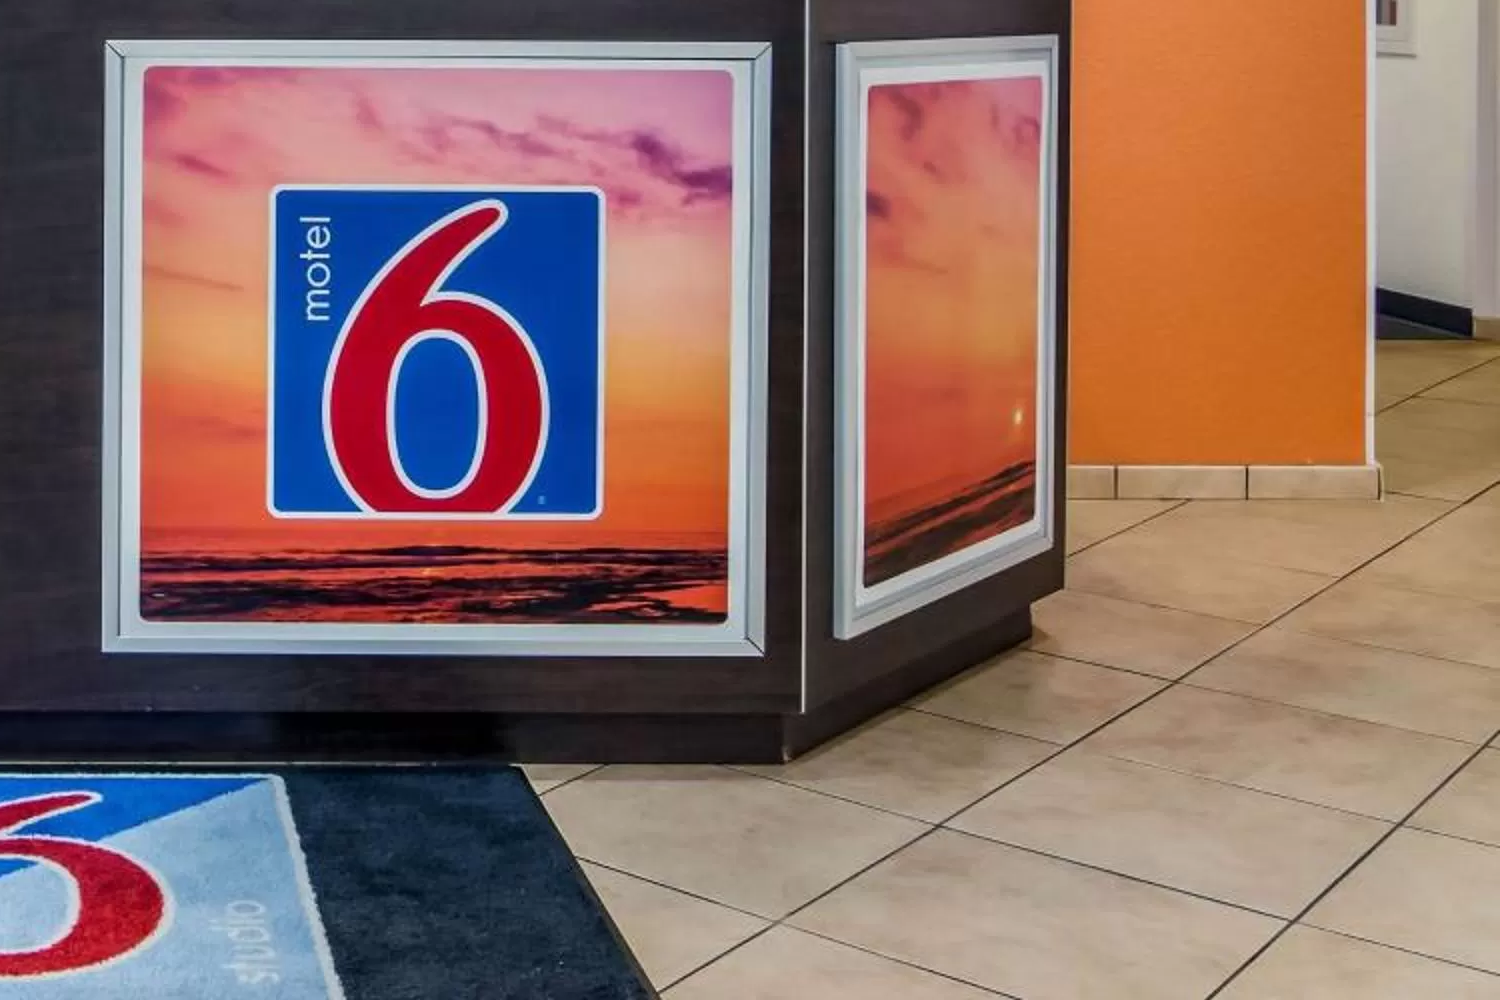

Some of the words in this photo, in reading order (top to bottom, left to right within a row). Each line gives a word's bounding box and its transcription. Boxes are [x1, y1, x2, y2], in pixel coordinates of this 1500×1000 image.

[299, 216, 331, 322] motel
[321, 198, 550, 515] 6
[207, 899, 281, 986] studio
